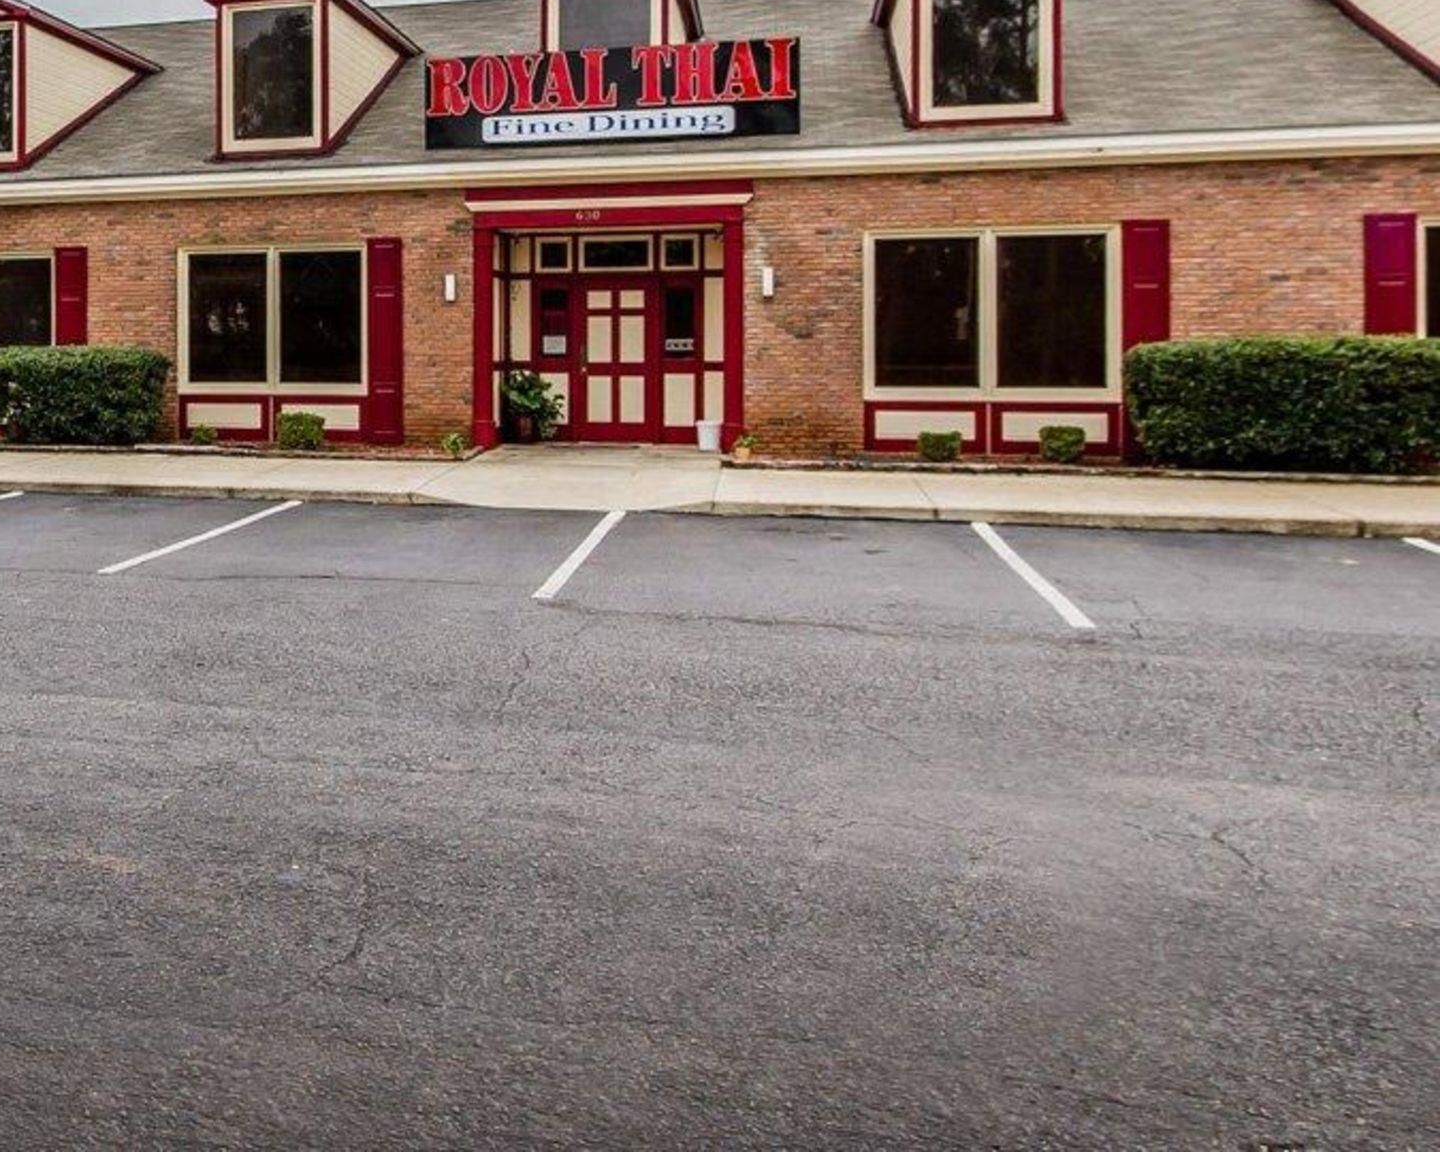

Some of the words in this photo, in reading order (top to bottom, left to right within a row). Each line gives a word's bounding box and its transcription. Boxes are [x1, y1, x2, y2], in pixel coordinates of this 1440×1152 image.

[426, 48, 617, 117] ROYAL
[632, 38, 797, 106] THAI
[492, 118, 574, 136] Fine
[588, 112, 727, 133] Dining
